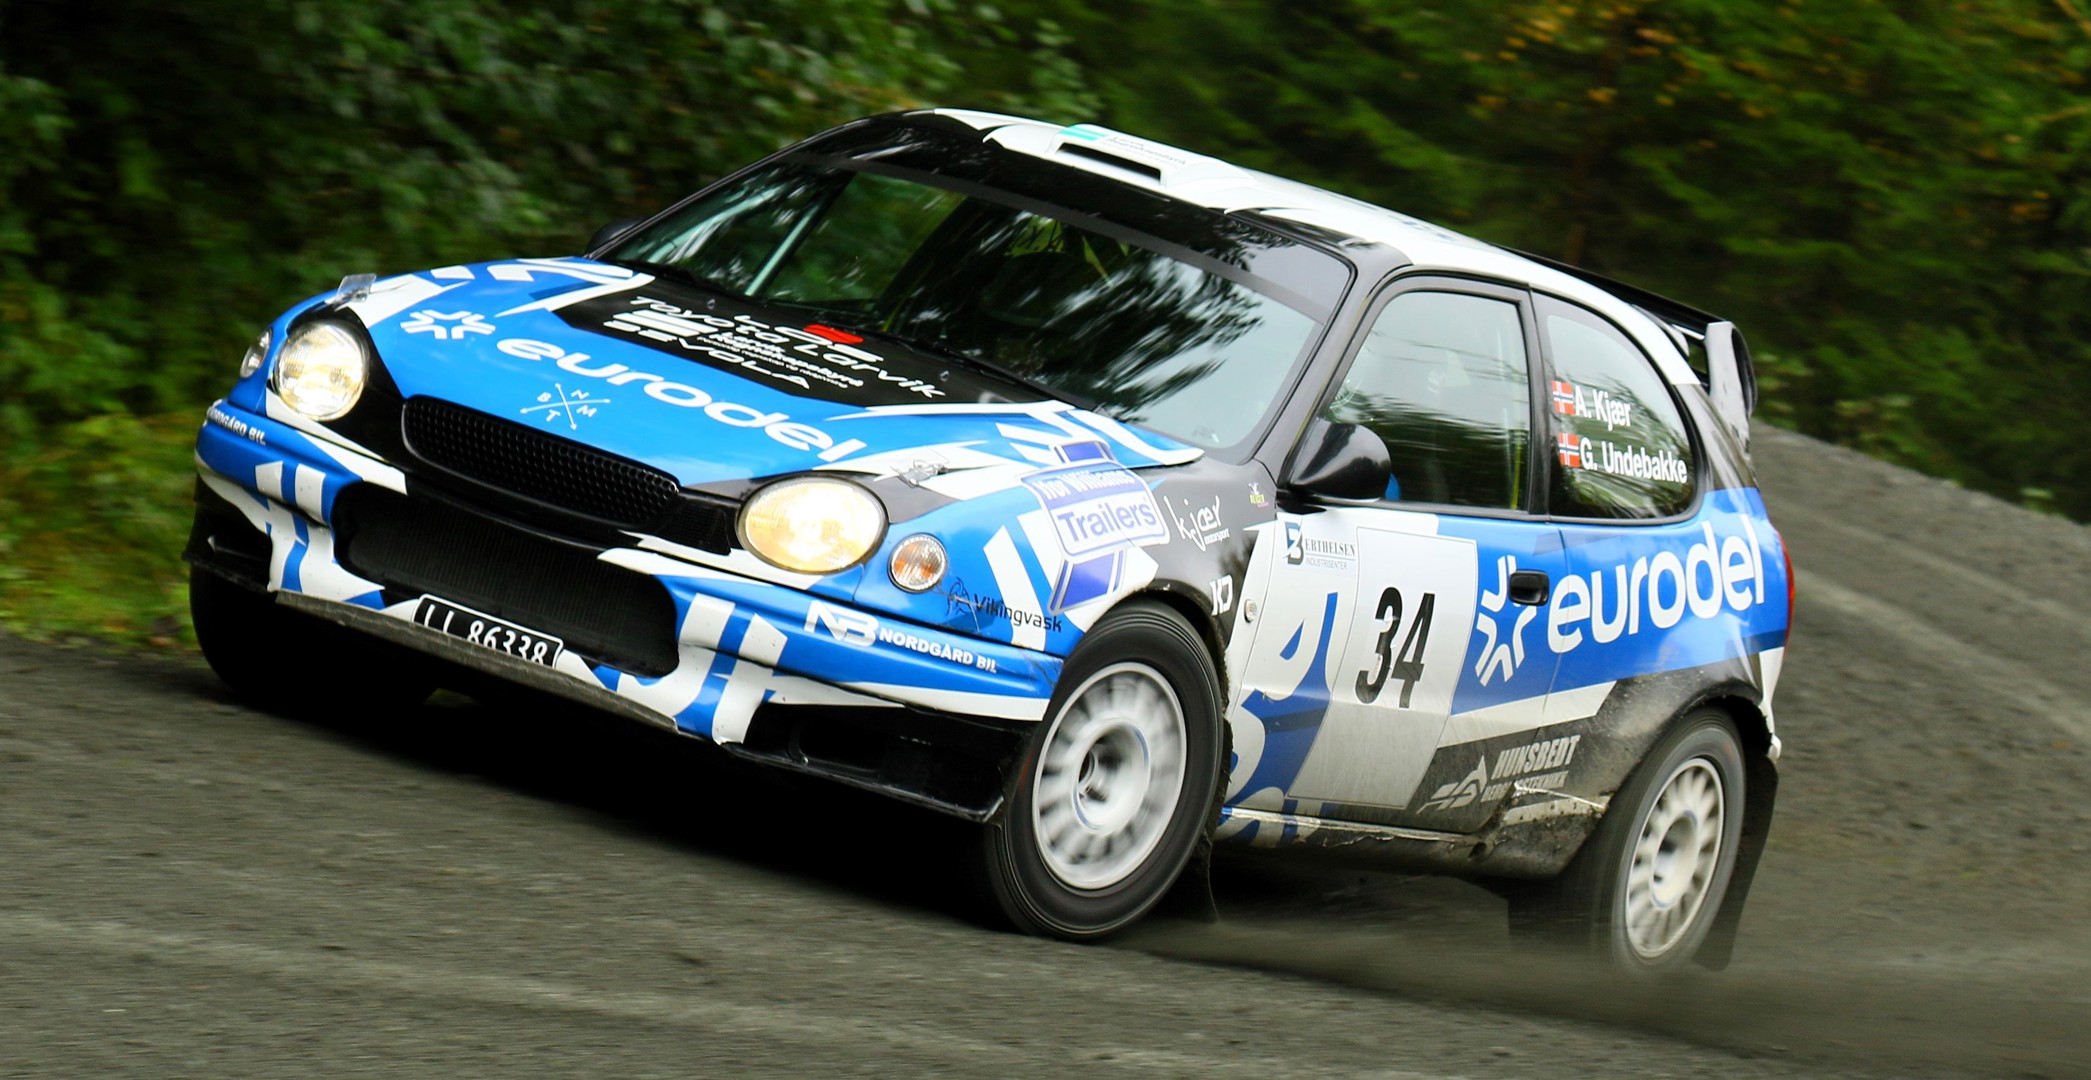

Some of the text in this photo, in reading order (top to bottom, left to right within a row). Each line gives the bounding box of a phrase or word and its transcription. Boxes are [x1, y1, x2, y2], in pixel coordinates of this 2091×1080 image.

[629, 296, 790, 344] Toyota
[793, 343, 947, 399] Larvik
[497, 339, 867, 462] eurodel
[537, 391, 552, 403] B
[545, 409, 561, 422] T
[1575, 385, 1631, 432] A. Kjær
[248, 426, 266, 446] BIL
[1580, 437, 1688, 484] G. Undebakke
[1057, 502, 1157, 542] Trailers
[1548, 513, 1765, 654] eurodel
[973, 593, 1062, 633] Vikingvask
[466, 619, 548, 667] 86338
[879, 626, 973, 666] NORDGÅRD
[975, 655, 997, 674] BIL
[1355, 586, 1435, 709] 34
[1490, 734, 1581, 780] HUNSBEDT
